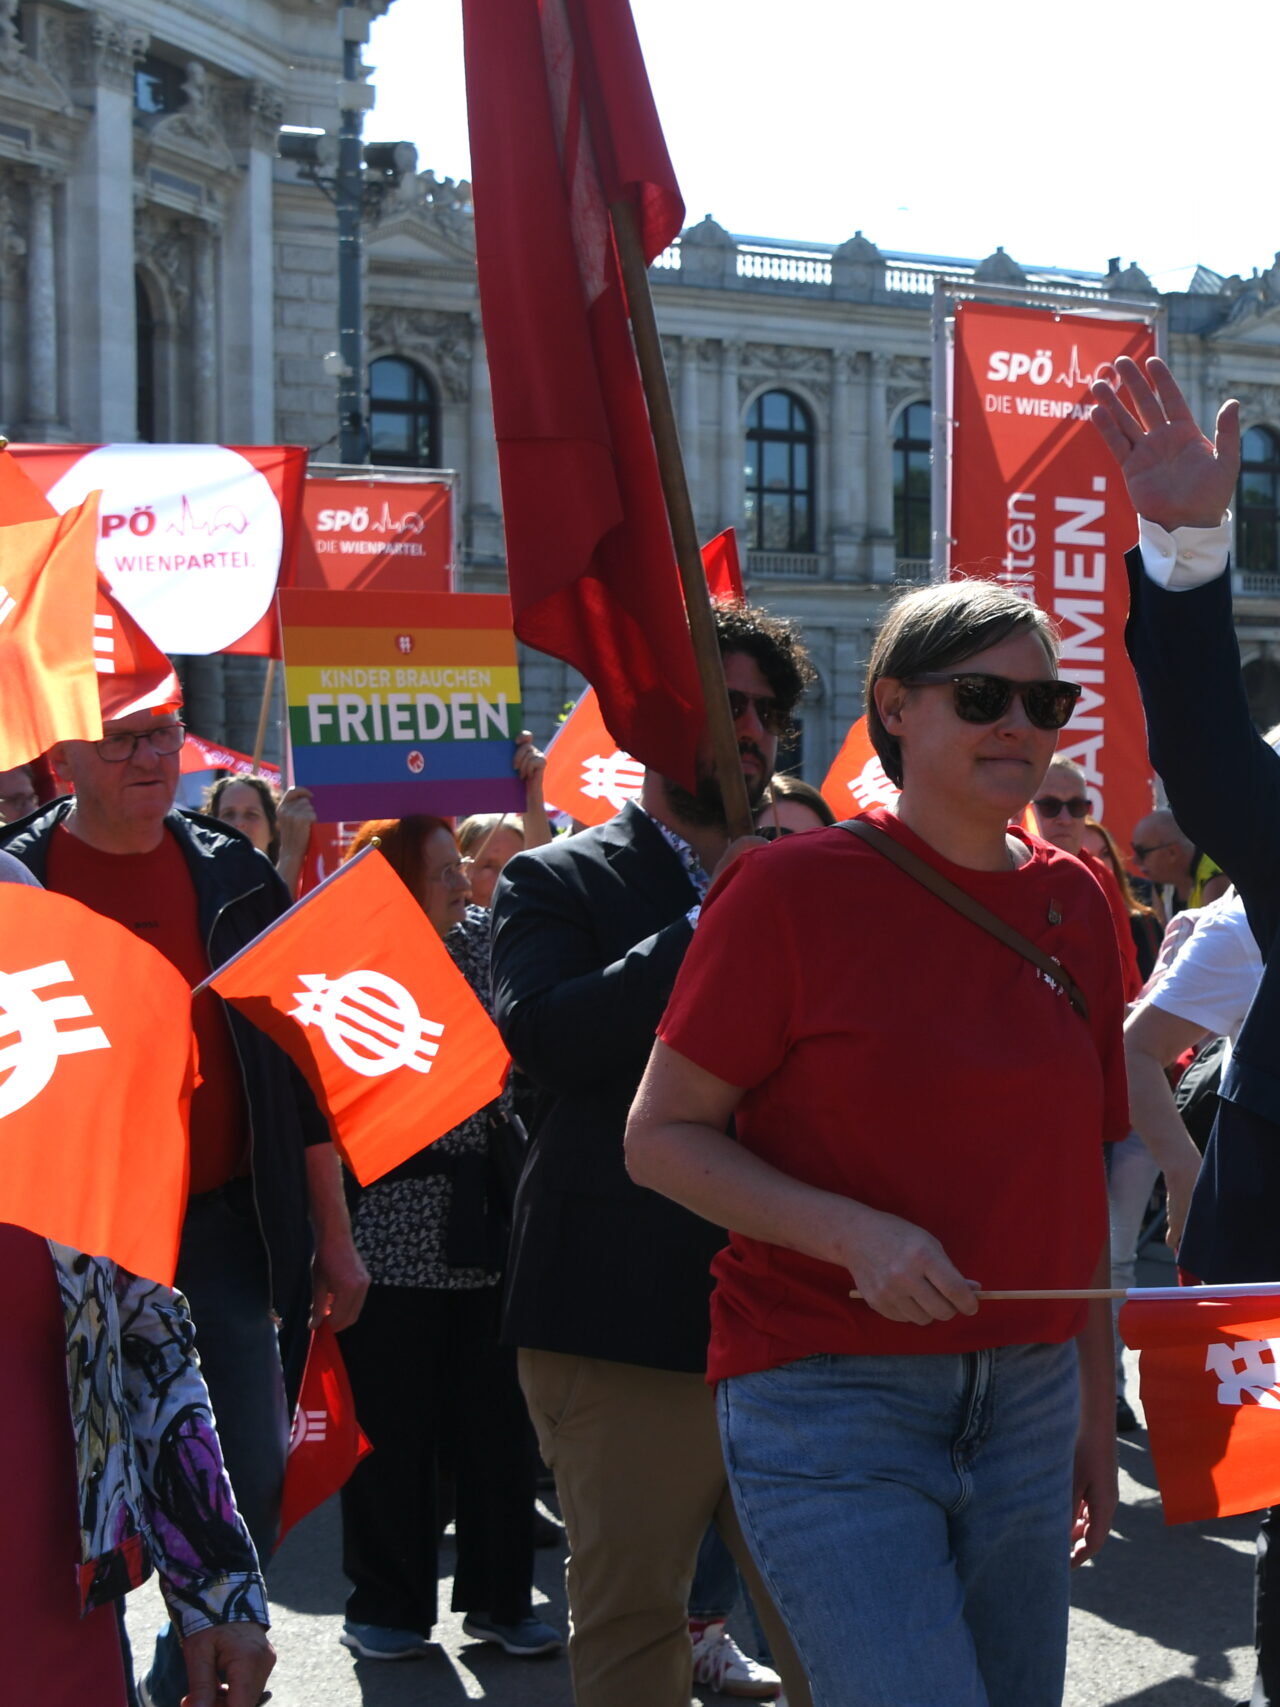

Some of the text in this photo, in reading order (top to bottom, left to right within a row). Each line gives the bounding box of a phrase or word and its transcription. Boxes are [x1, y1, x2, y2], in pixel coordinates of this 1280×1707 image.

[987, 349, 1053, 385] SPÖ
[985, 393, 1092, 421] DIE WIENPAR
[101, 505, 156, 539] PÖ
[316, 506, 369, 532] SPÖ
[115, 551, 256, 572] WIENPARTEI.
[315, 540, 426, 556] DIE WIENPARTEI.
[320, 669, 491, 688] KINDER BRAUCHEN
[308, 692, 510, 743] FRIEDEN
